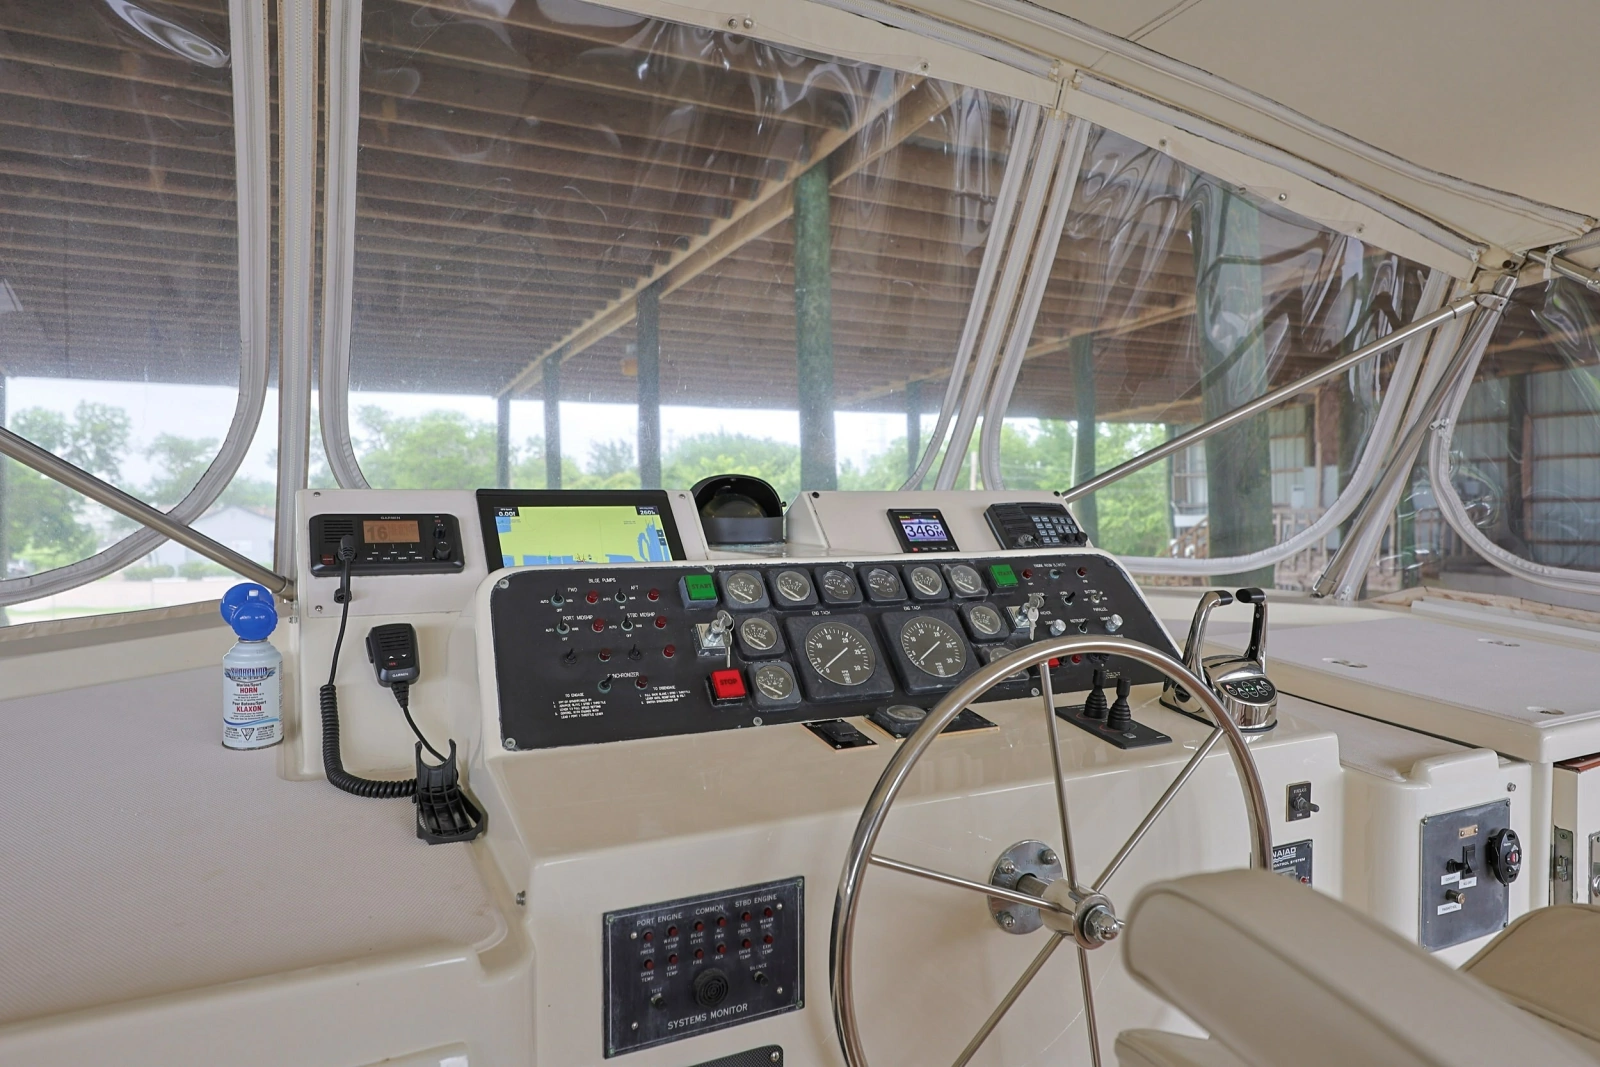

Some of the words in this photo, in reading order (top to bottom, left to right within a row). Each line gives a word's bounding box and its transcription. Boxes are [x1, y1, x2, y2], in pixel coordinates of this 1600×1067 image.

[367, 526, 388, 540] 16
[735, 899, 751, 908] STBD
[754, 894, 777, 904] ENGINE
[696, 905, 724, 915] COMMON
[637, 918, 654, 926] PORT
[658, 912, 682, 923] ENGINE
[667, 1013, 707, 1030] SYSTEMS
[711, 1003, 748, 1020] MONITOR
